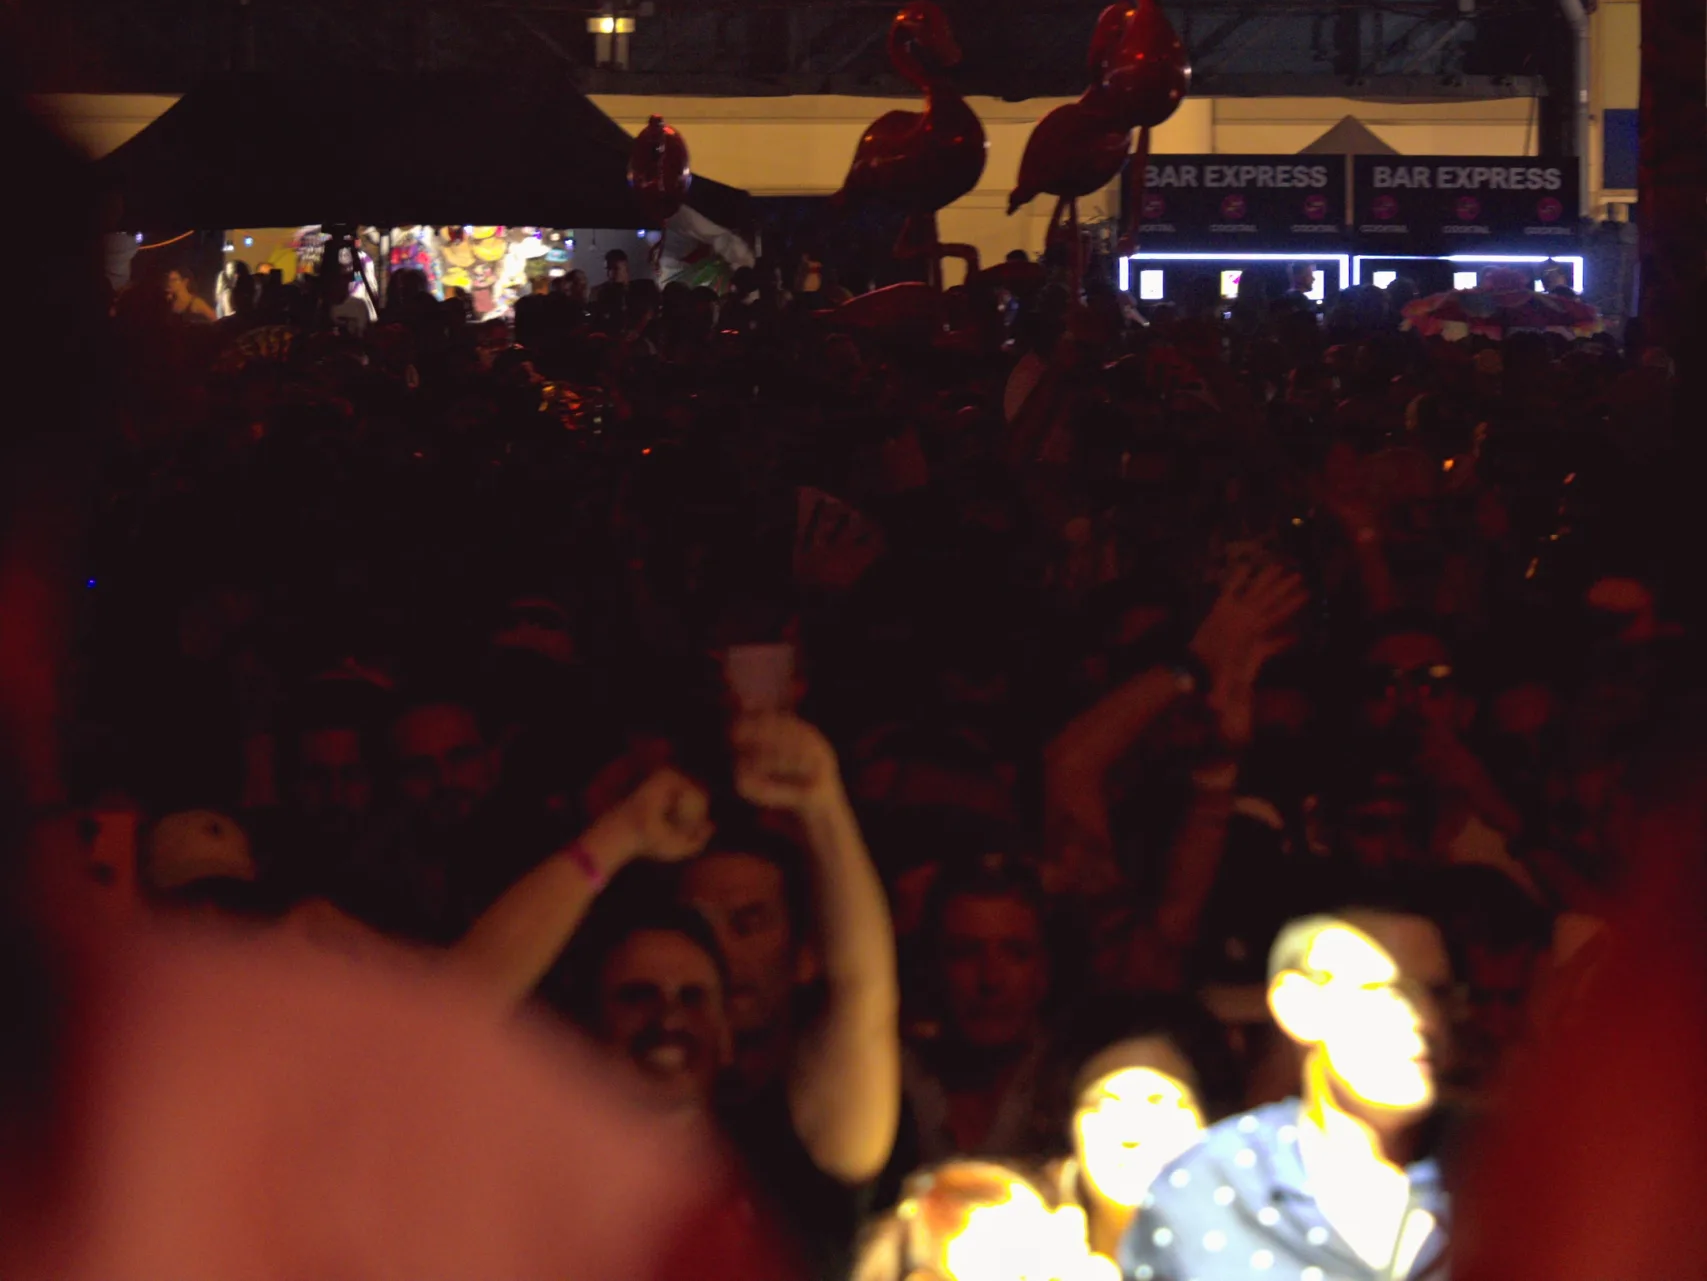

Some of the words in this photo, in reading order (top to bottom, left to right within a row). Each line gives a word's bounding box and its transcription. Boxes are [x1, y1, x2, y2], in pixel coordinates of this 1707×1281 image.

[1144, 165, 1199, 188] BAR
[1203, 165, 1329, 188] EXPRESS
[1372, 166, 1432, 189] BAR
[1436, 166, 1563, 190] EXPRESS
